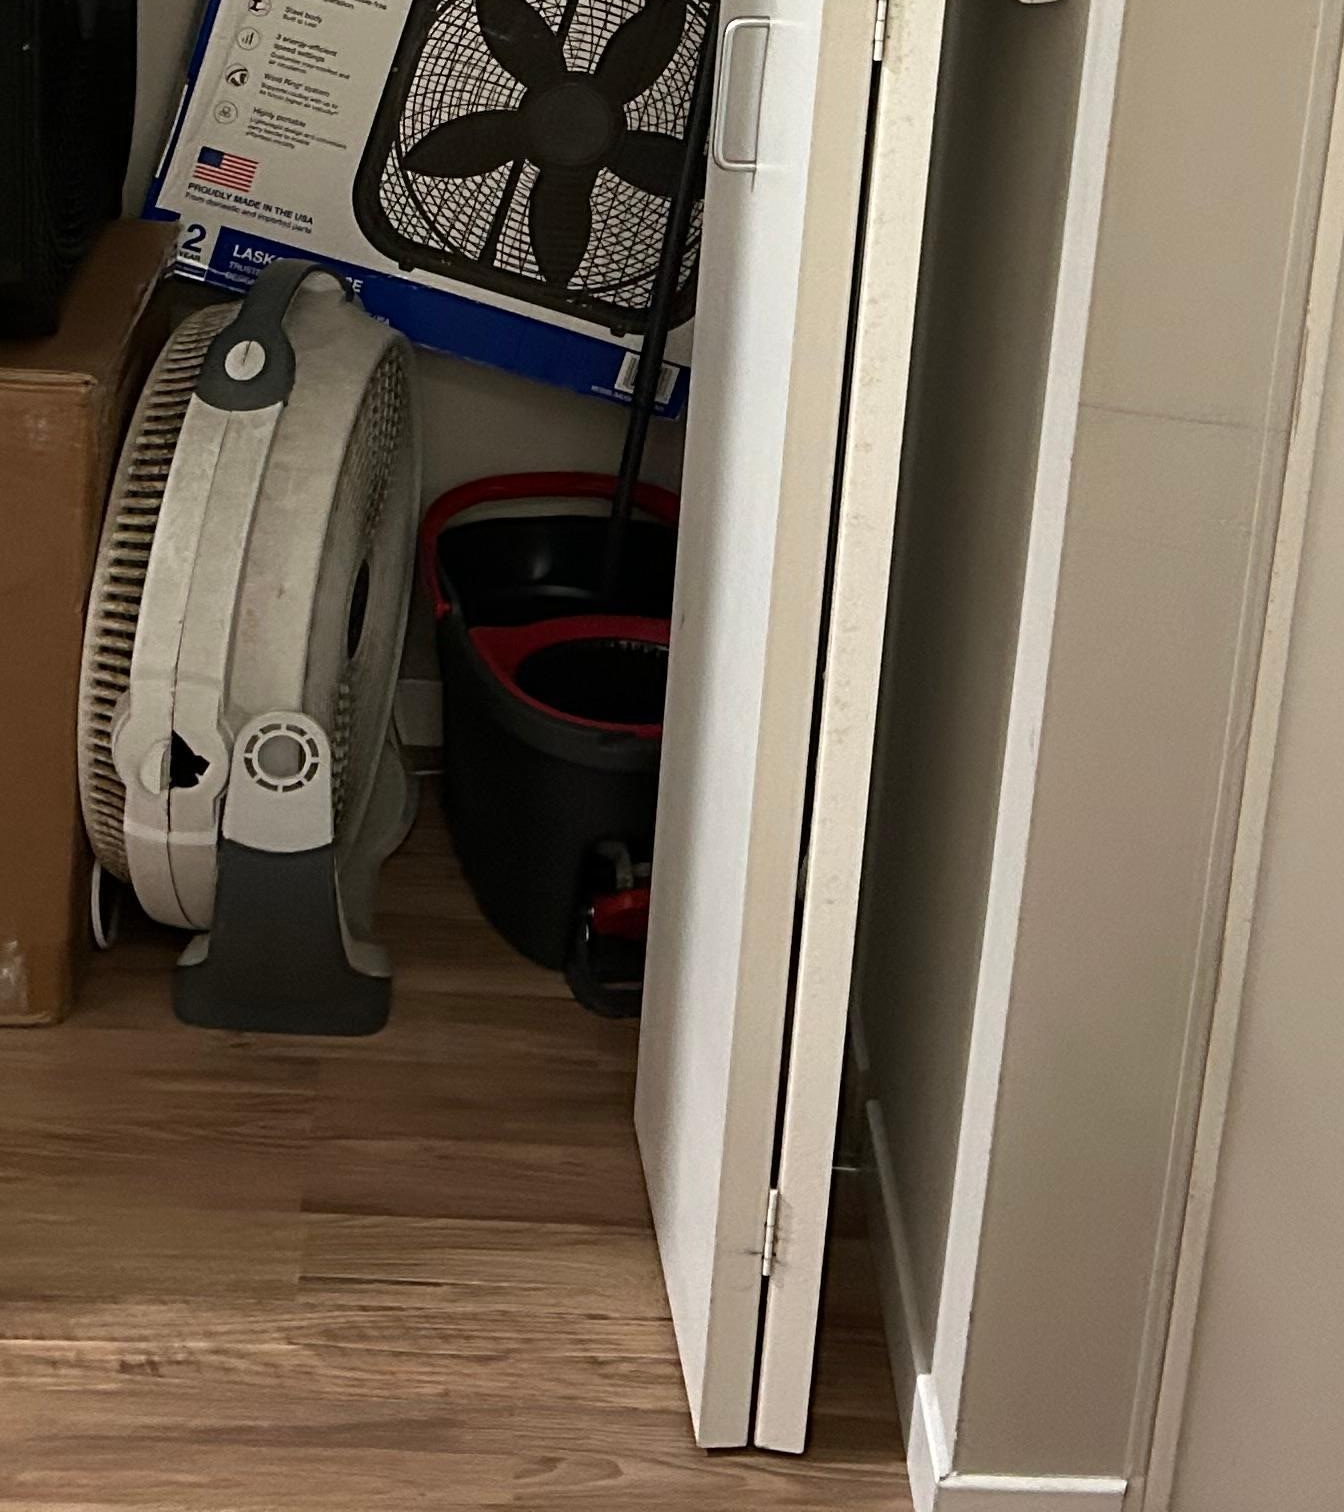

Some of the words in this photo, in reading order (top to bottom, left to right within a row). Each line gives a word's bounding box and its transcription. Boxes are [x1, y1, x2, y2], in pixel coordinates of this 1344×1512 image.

[187, 182, 233, 201] PROUDLY
[234, 195, 261, 210] MADE
[263, 202, 273, 213] IN
[274, 206, 294, 219] THE
[295, 211, 314, 225] USA
[181, 224, 207, 253] 2
[178, 250, 202, 261] YEAR
[232, 244, 284, 266] LASK
[229, 260, 261, 276] TRUST
